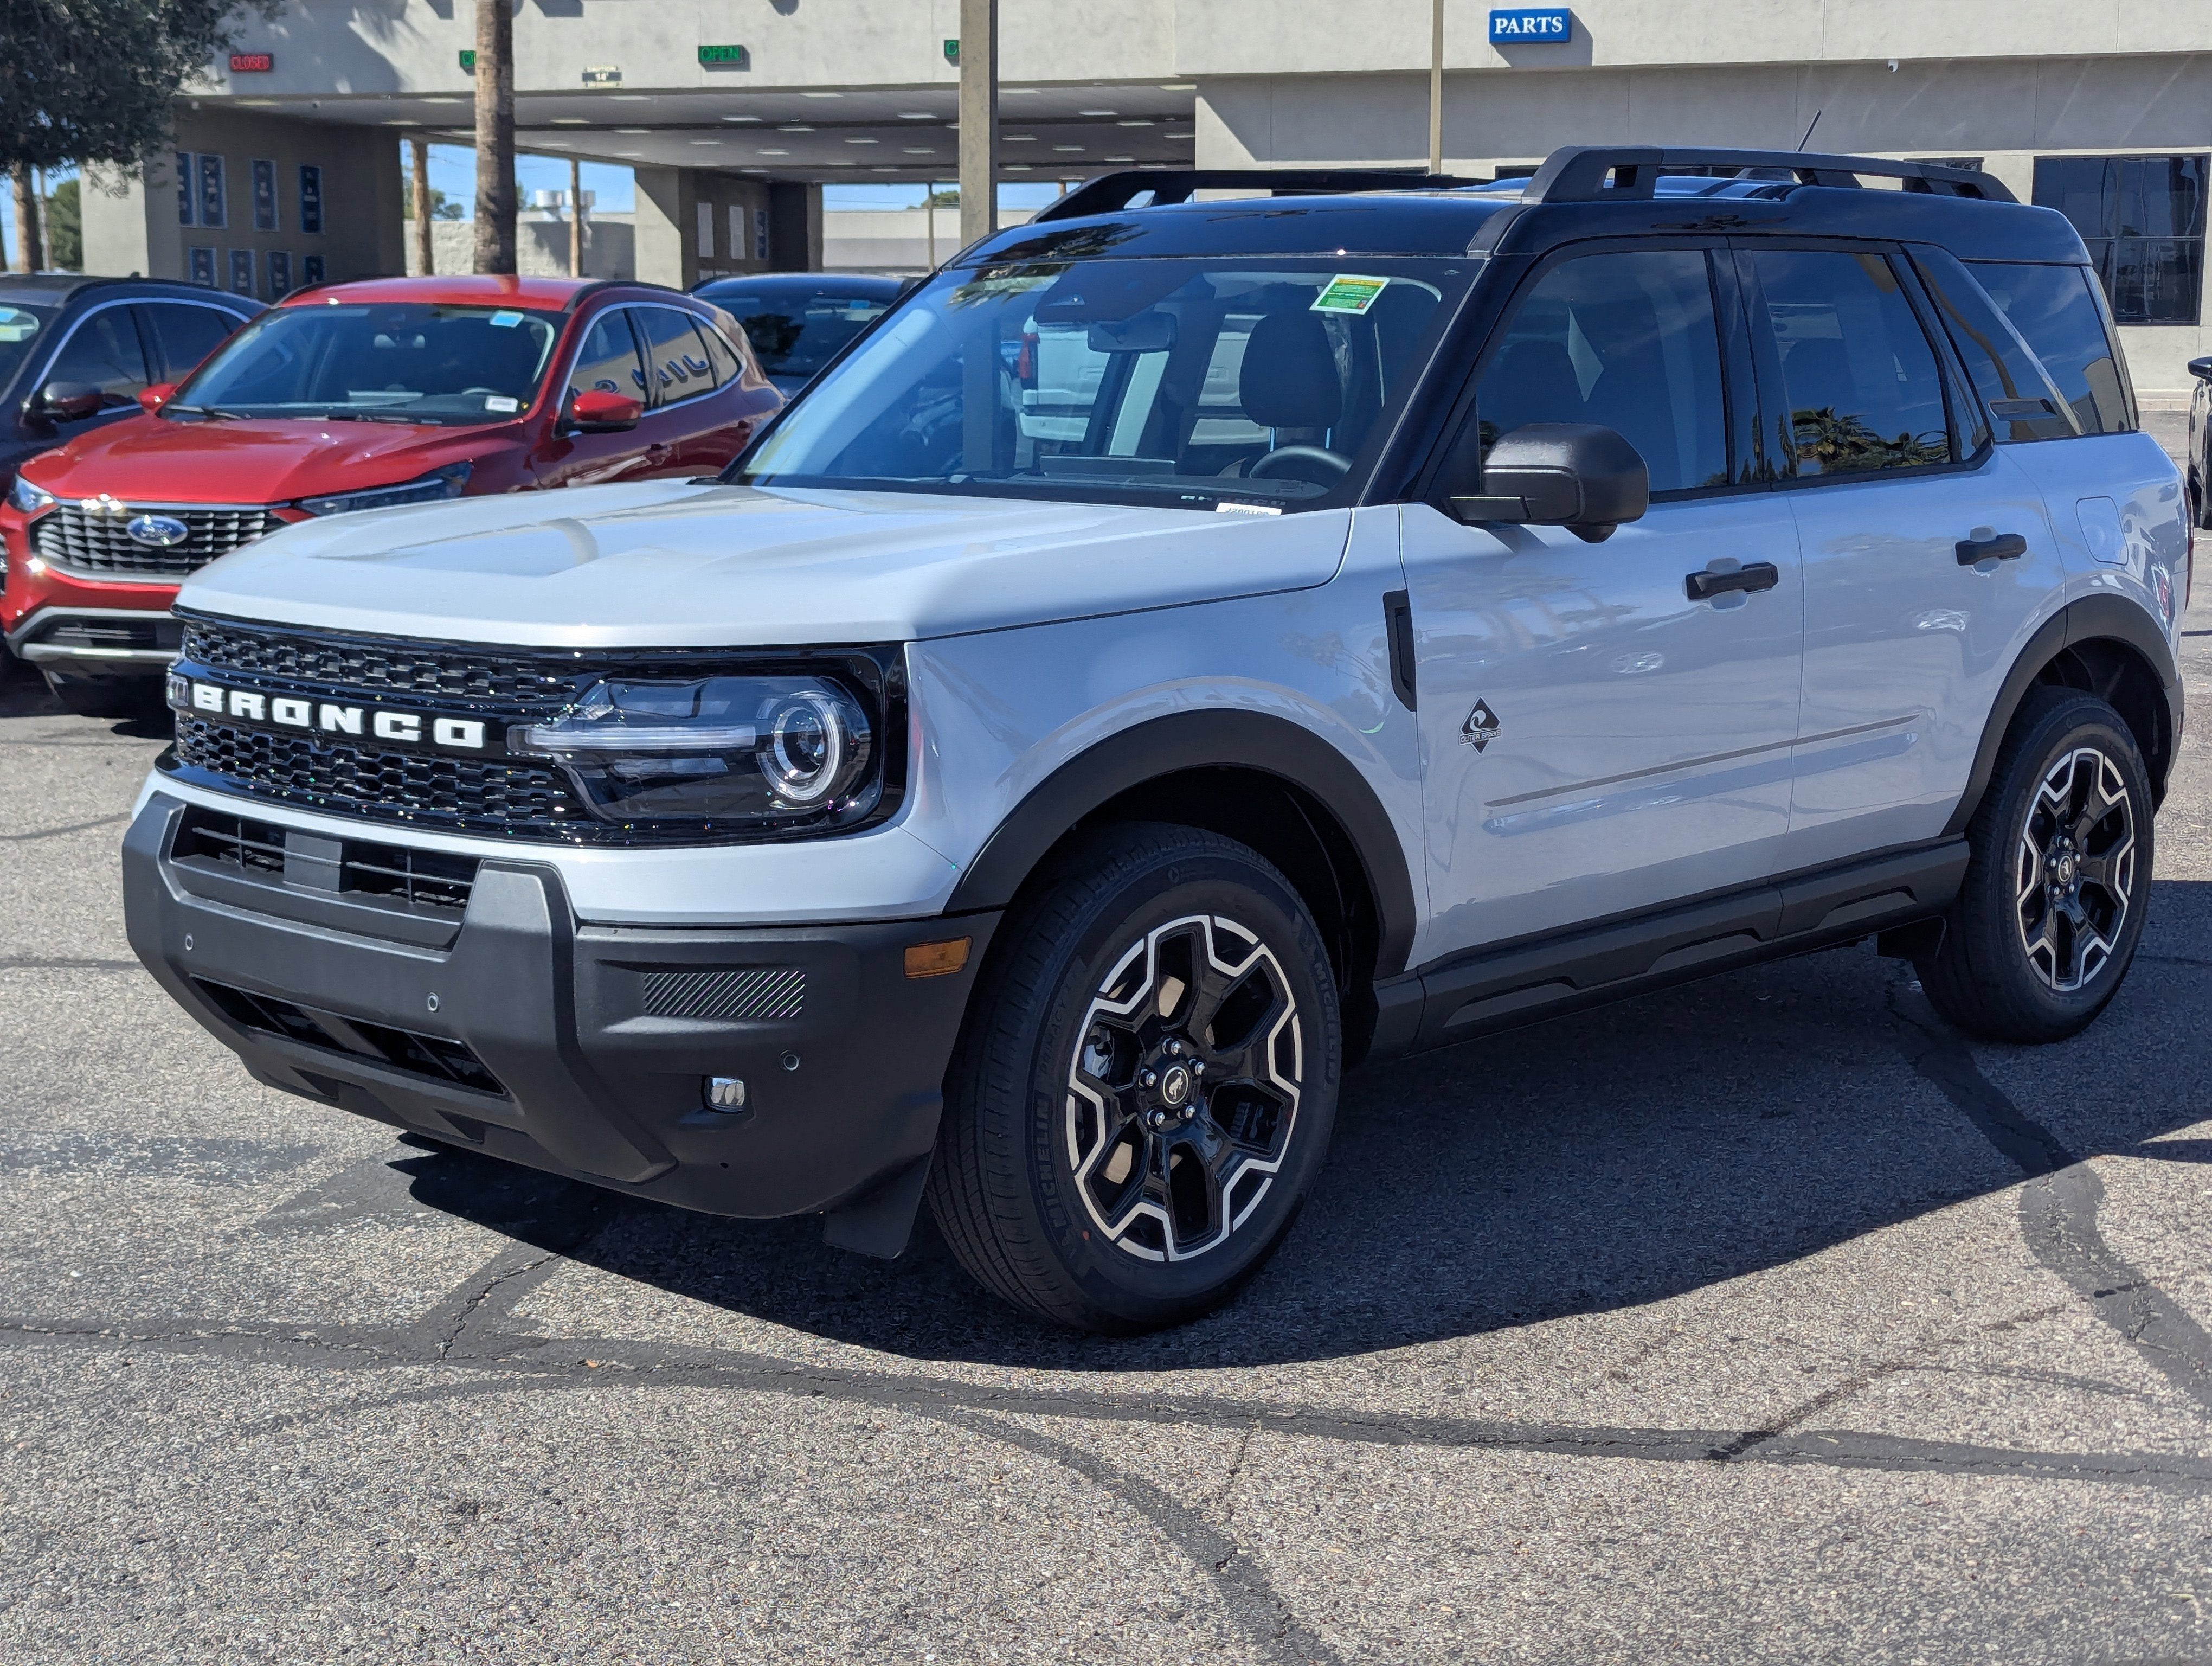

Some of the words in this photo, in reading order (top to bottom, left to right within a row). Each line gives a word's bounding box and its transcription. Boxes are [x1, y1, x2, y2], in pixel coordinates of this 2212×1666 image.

[1494, 16, 1563, 34] PARTS
[701, 47, 739, 61] OPEN
[193, 683, 486, 748] BRONCO
[1034, 1097, 1068, 1229] MICHELIN
